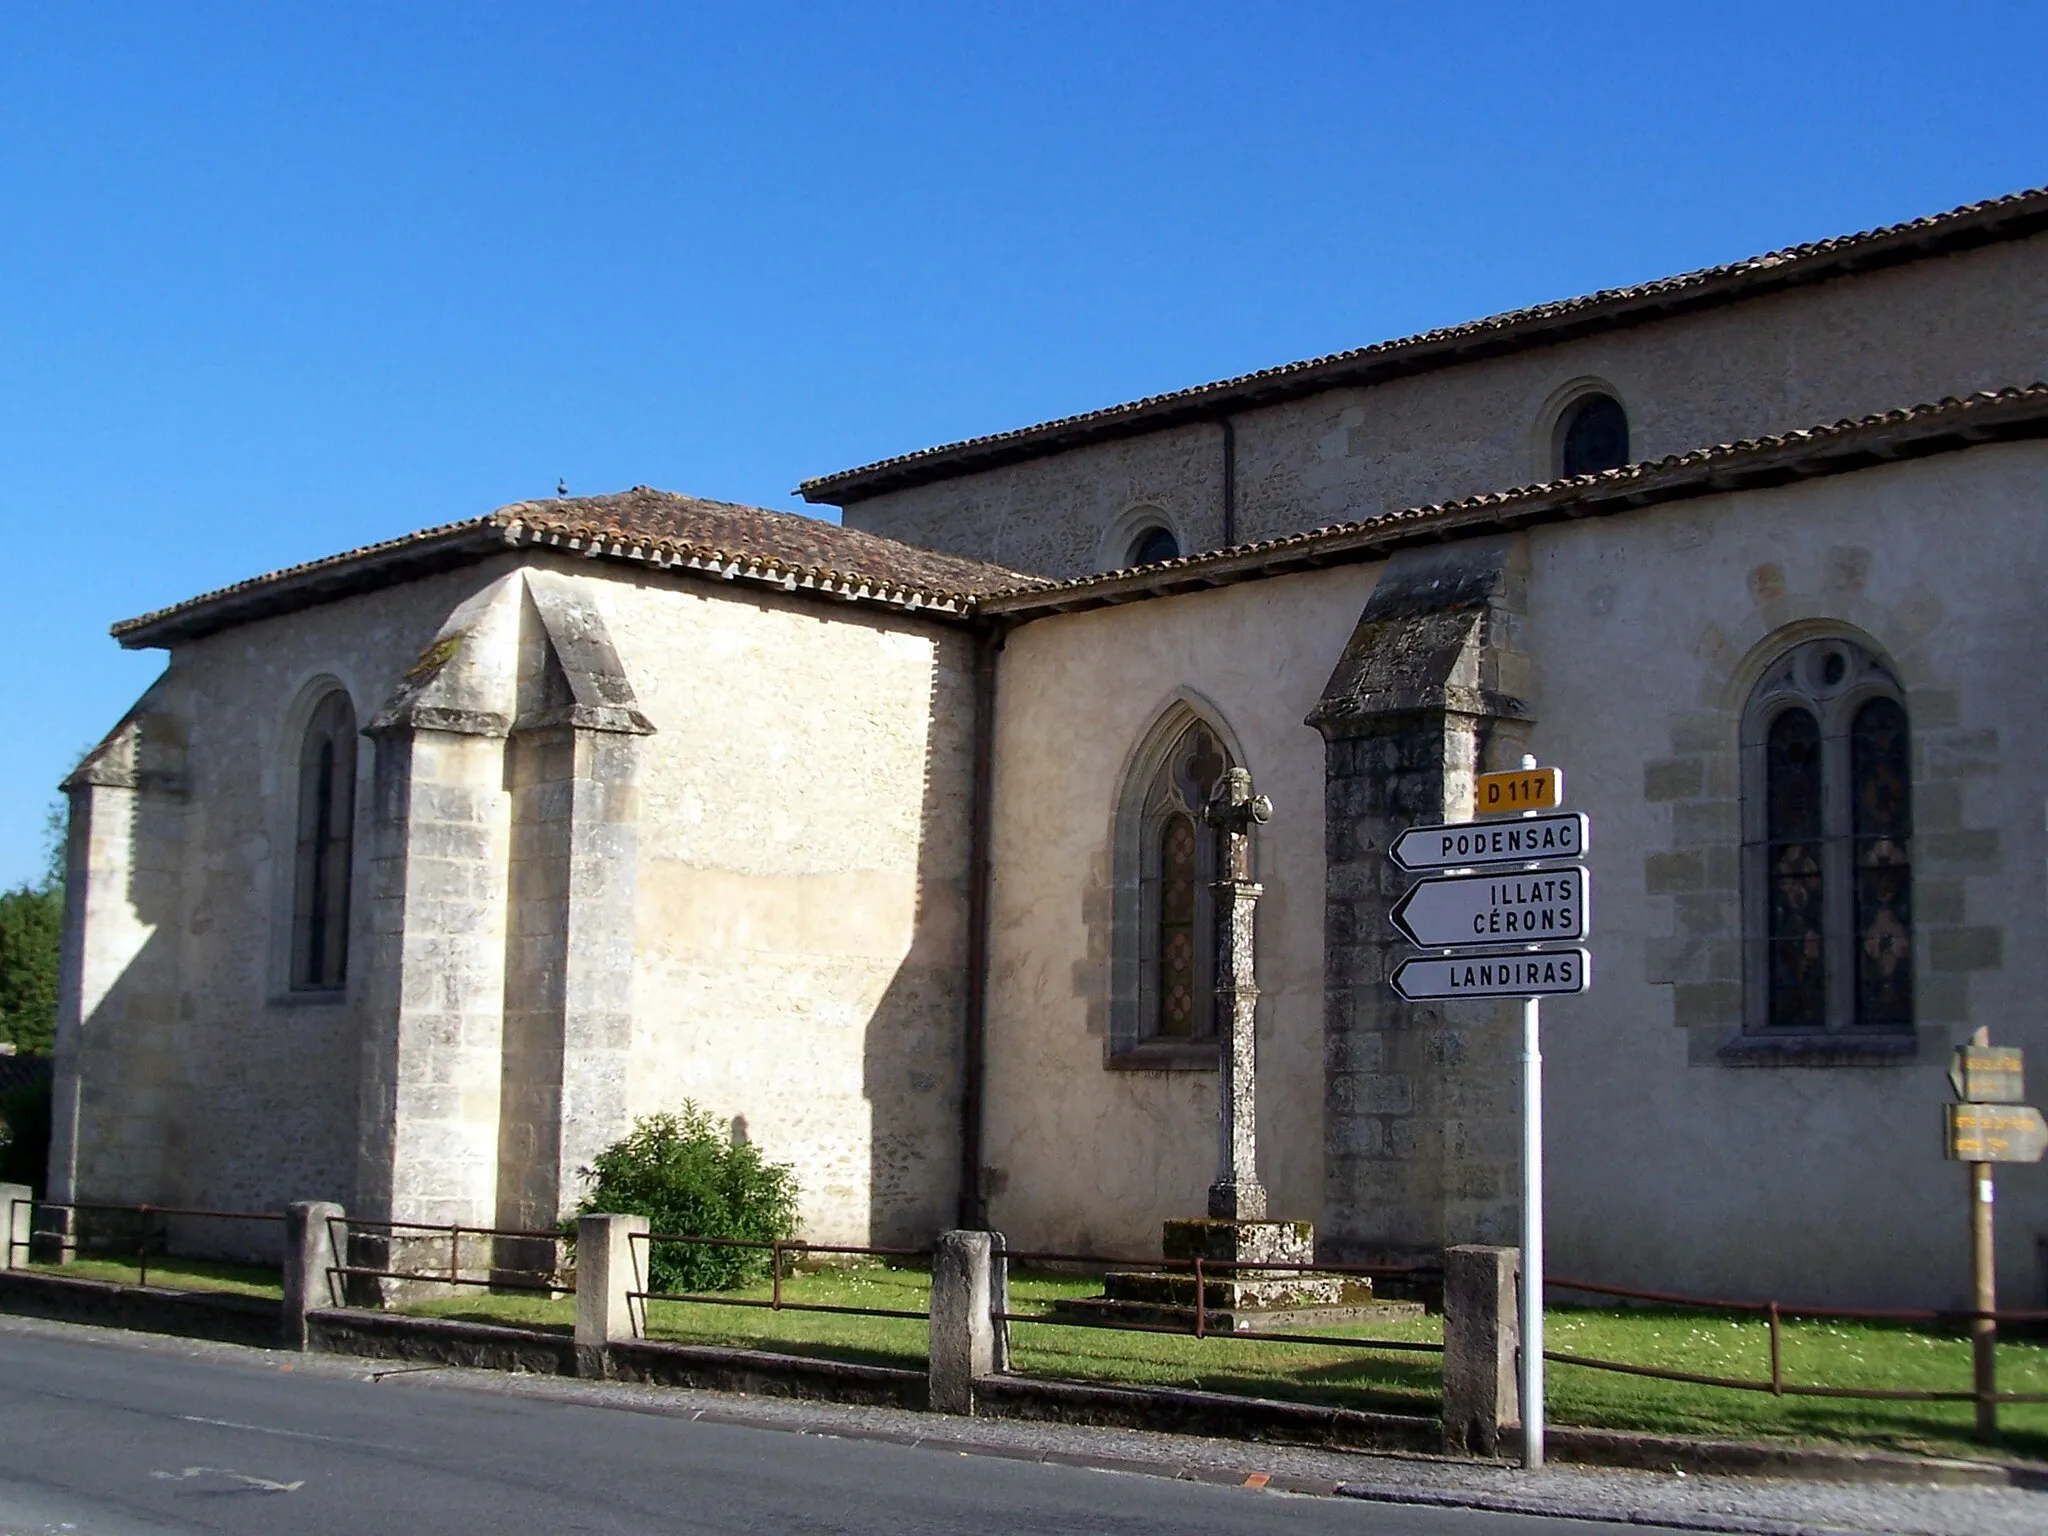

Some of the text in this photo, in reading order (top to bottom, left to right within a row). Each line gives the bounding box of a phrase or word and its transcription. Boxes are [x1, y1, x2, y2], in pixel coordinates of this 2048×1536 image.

[1488, 778, 1546, 804] D 117
[1442, 826, 1572, 857] PODENSAC
[1491, 879, 1572, 906] ILLATS
[1474, 908, 1573, 934] CÉRONS
[1451, 961, 1573, 988] LANDIRAS
